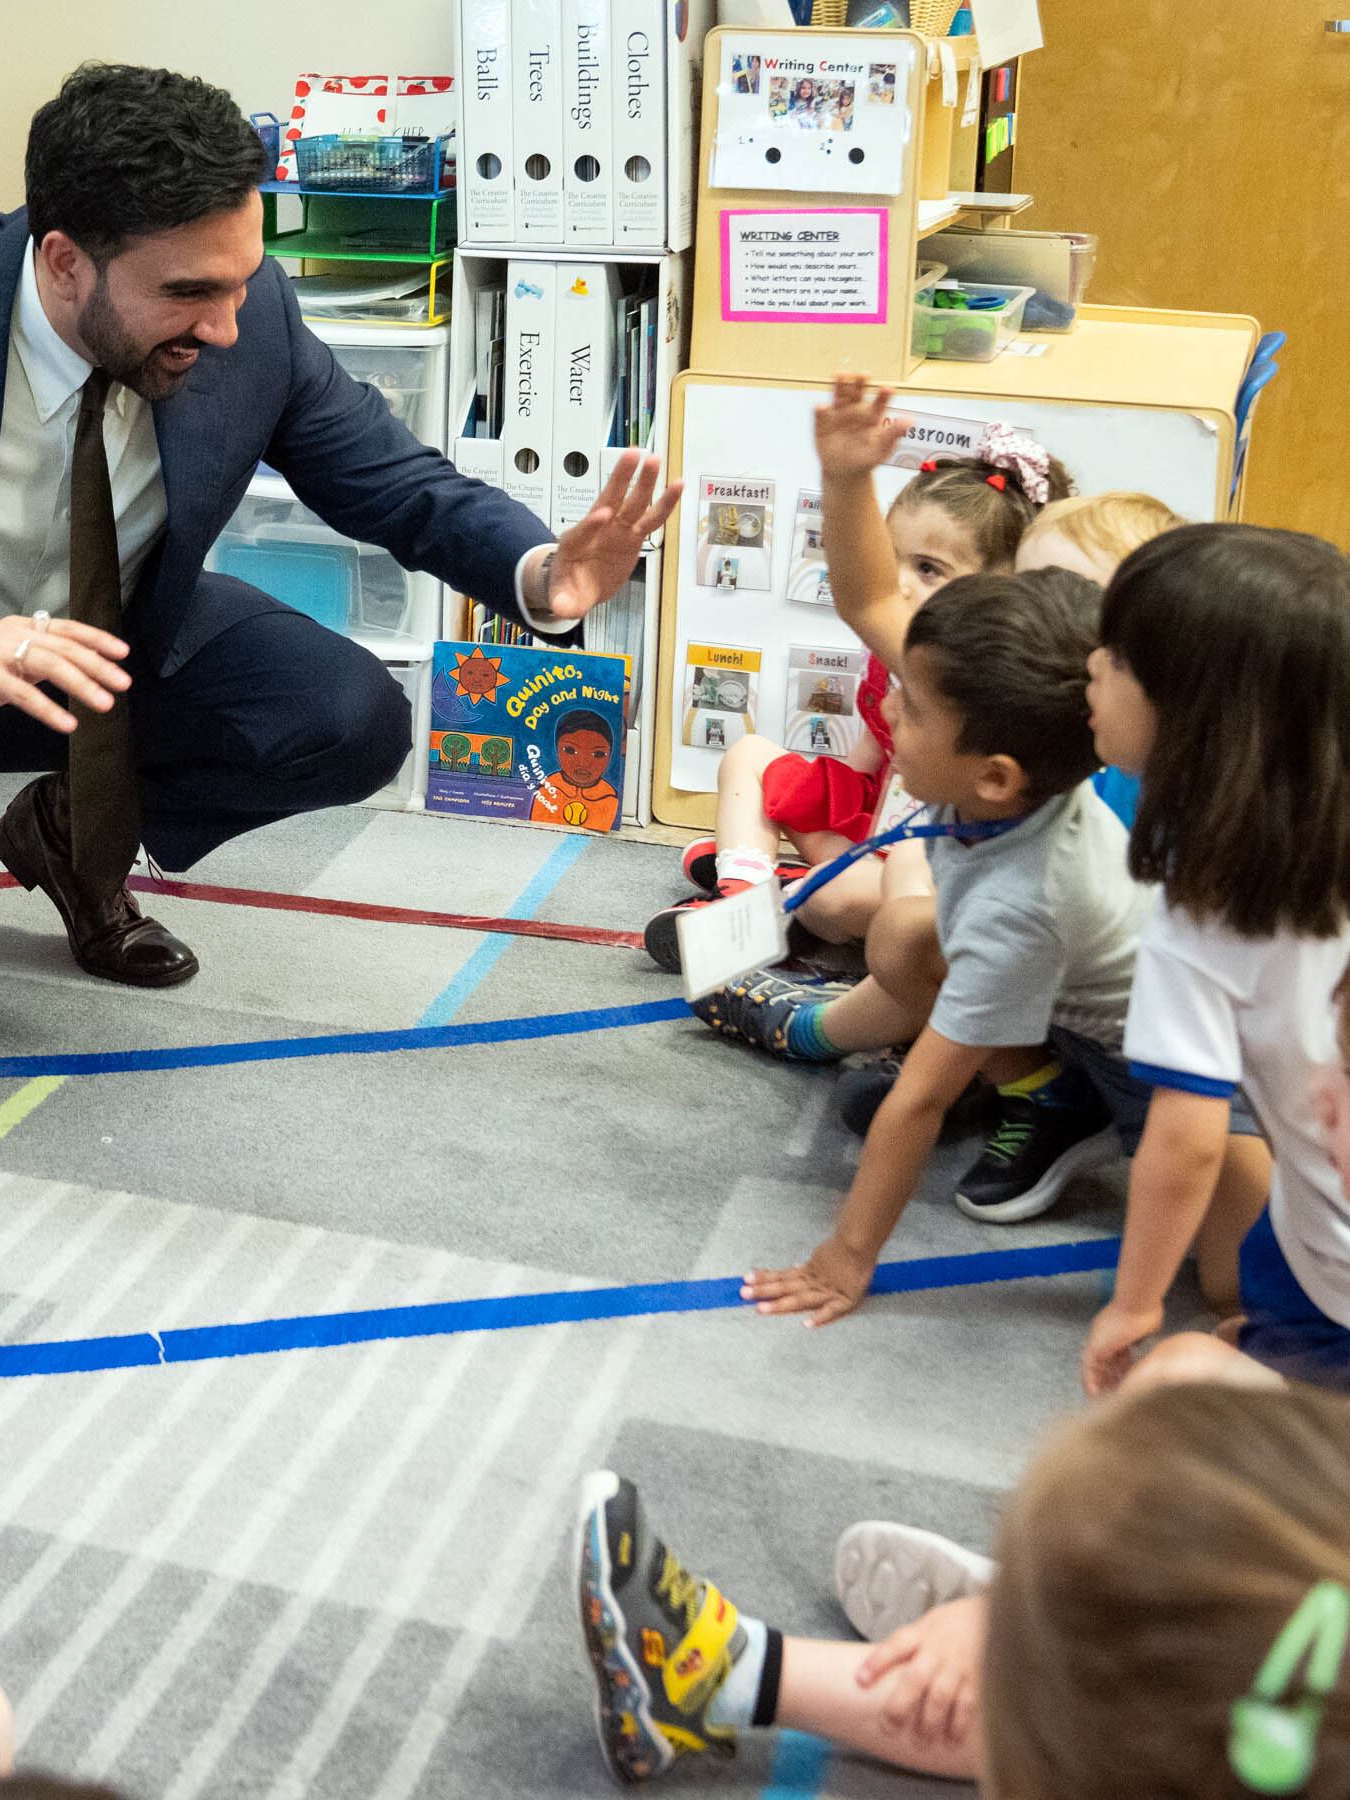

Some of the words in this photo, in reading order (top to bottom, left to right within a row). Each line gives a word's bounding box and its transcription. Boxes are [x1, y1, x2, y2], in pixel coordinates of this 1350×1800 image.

[476, 47, 499, 101] Balls
[529, 45, 550, 102] Trees
[764, 58, 815, 74] Writing
[819, 61, 864, 74] Center
[571, 24, 600, 130] Buildings
[627, 31, 650, 120] Clothes
[740, 231, 793, 241] WRITING
[797, 231, 840, 241] CENTER
[750, 249, 764, 257] Tell
[778, 250, 815, 259] something
[817, 250, 837, 258] about
[839, 251, 855, 259] your
[750, 262, 765, 270] How
[751, 274, 770, 282] What
[772, 274, 798, 282] letters
[772, 287, 798, 295] letters
[750, 299, 765, 307] How
[778, 300, 790, 308] you
[518, 331, 541, 417] Exercise
[569, 343, 591, 407] Water
[882, 416, 971, 448] ssroom
[557, 485, 568, 493] The
[706, 482, 770, 500] Breakfast!
[707, 650, 743, 666] Lunch!
[808, 652, 848, 668] Snack!
[506, 664, 583, 717] Quinito,
[524, 702, 550, 730] Day
[551, 688, 577, 706] and
[582, 685, 620, 704] Night
[526, 782, 537, 791] y
